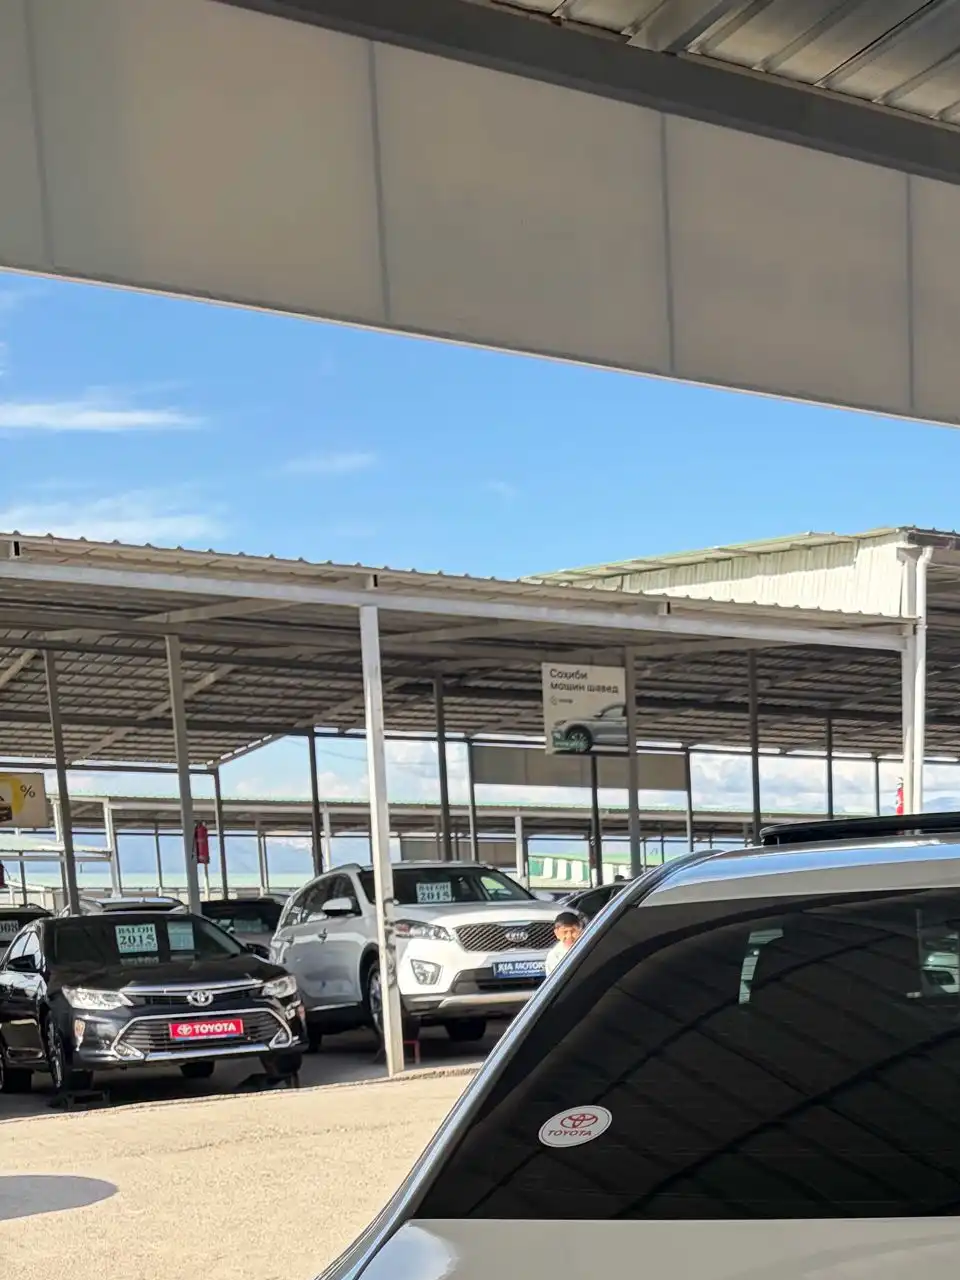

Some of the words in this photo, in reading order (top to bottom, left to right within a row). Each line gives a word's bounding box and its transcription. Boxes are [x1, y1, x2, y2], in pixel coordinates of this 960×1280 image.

[119, 934, 155, 945] 2015
[498, 963, 513, 971] KIA
[193, 1022, 236, 1034] TOYOTA
